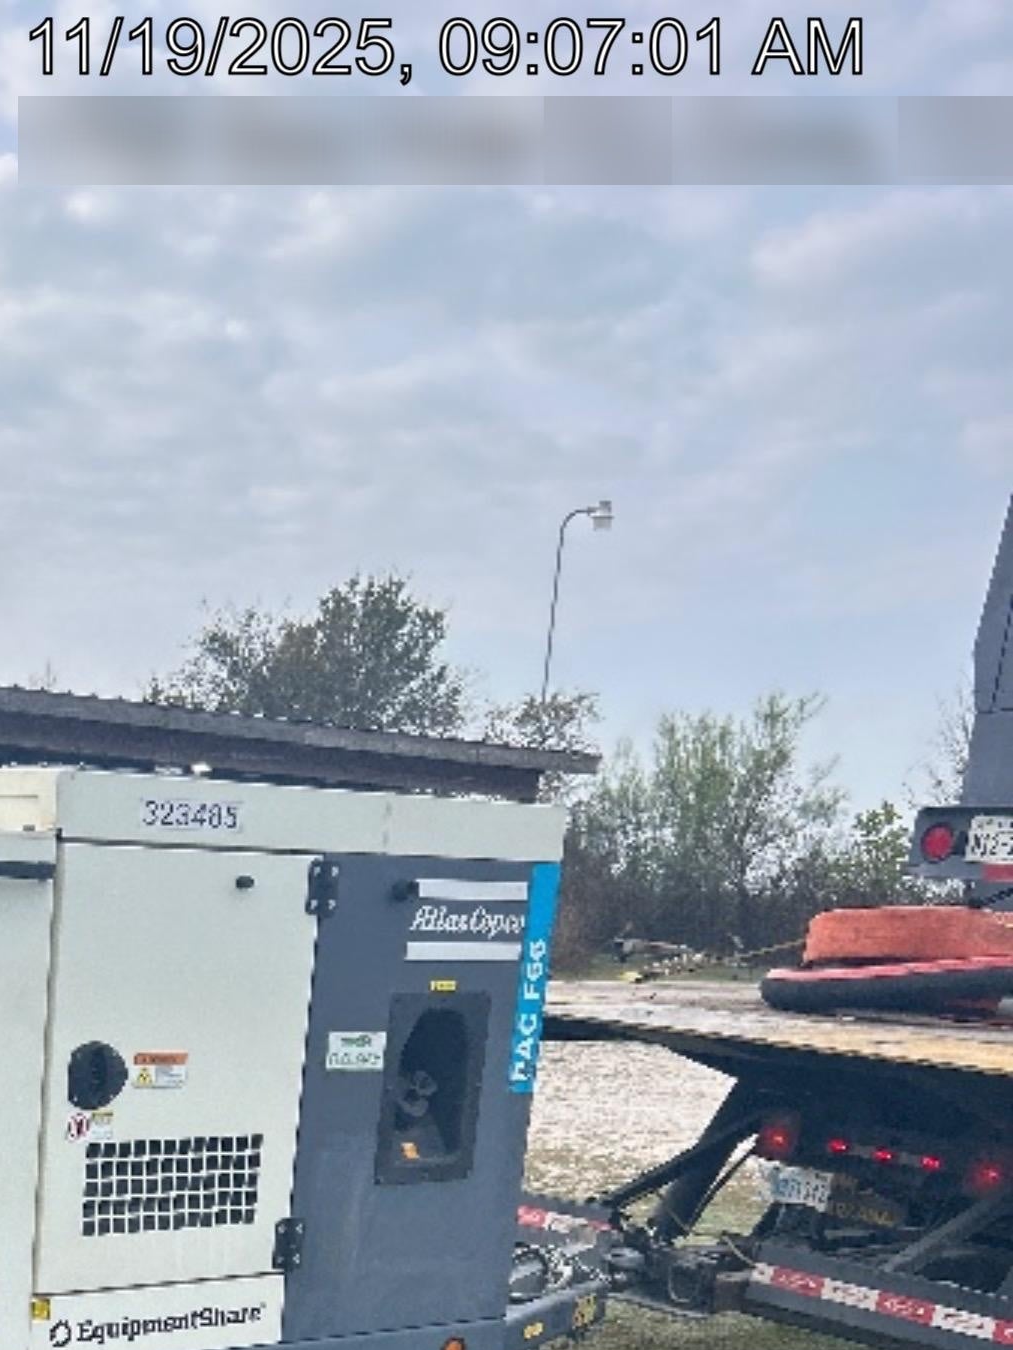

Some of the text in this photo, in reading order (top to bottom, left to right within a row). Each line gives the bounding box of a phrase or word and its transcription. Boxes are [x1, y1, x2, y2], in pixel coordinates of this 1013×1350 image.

[409, 905, 468, 932] Atlas
[508, 937, 548, 1082] PAC F66
[76, 1304, 263, 1345] EquipmentShare
